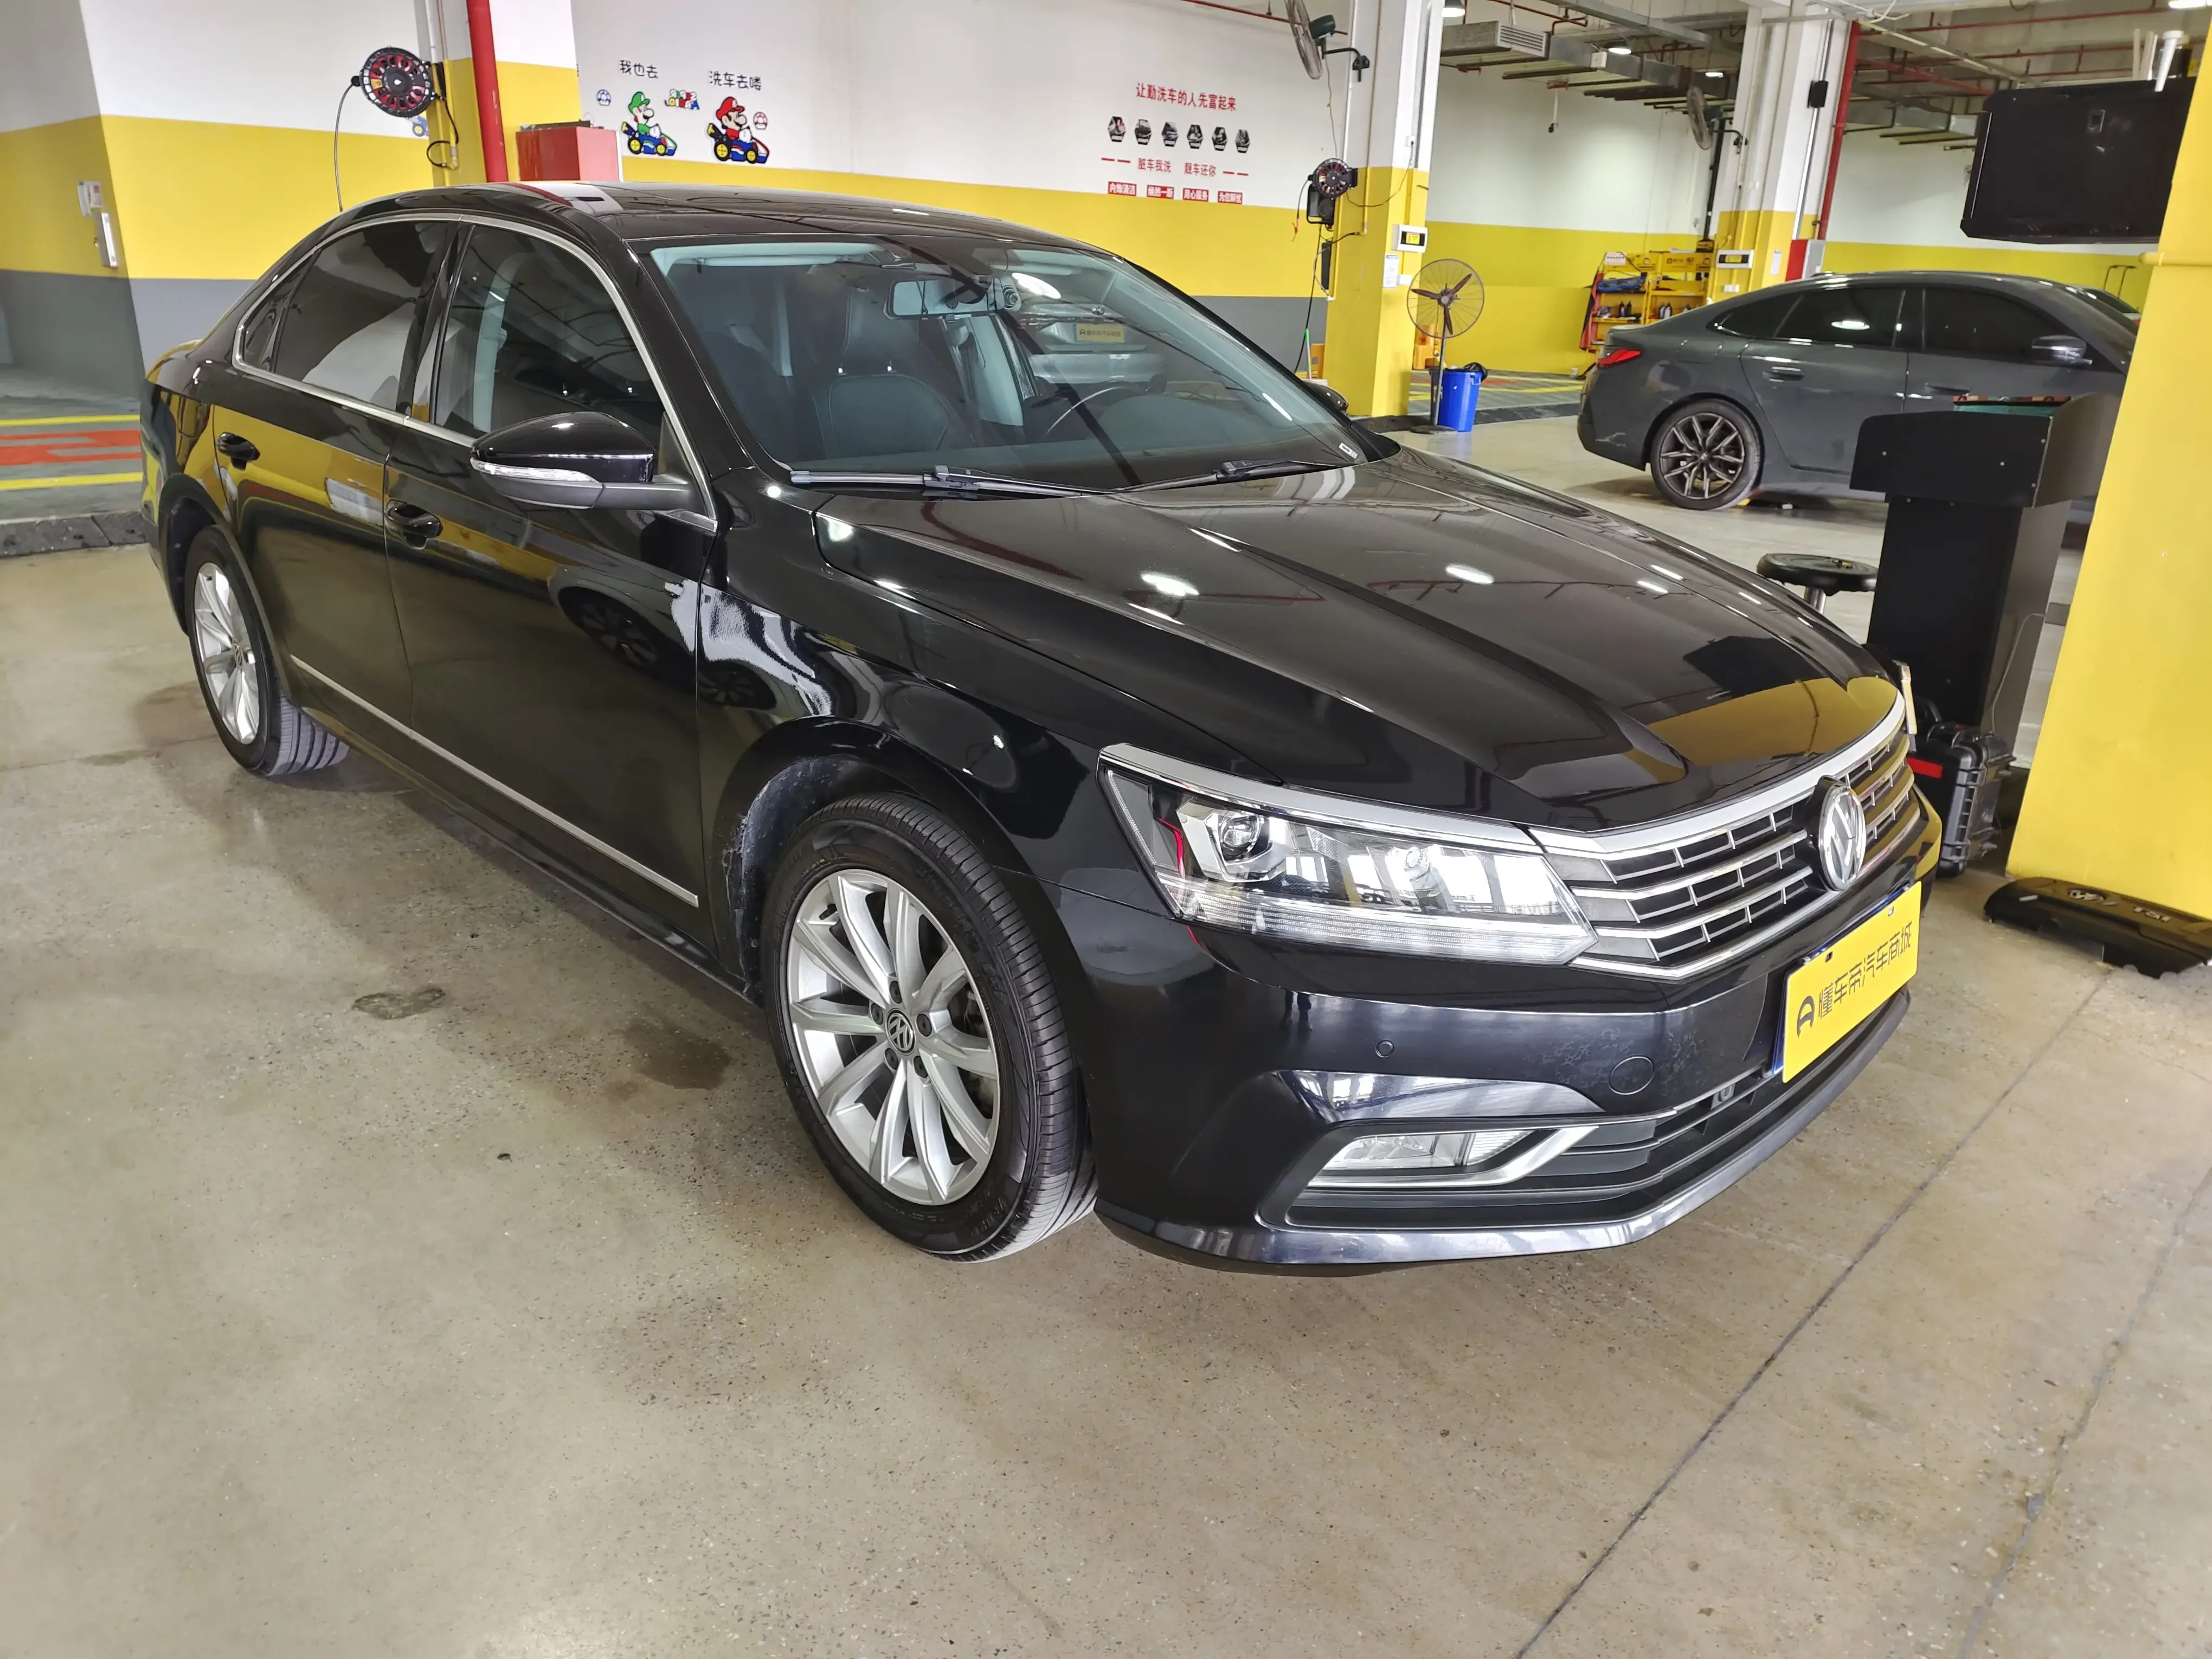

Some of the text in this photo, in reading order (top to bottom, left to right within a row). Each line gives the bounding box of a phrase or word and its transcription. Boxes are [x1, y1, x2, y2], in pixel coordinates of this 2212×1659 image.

[620, 60, 659, 79] 我也去
[1135, 82, 1237, 112] 让勤洗车的人先富起来
[1137, 157, 1172, 173] 脏车我洗
[1818, 921, 1912, 1019] 懂车帝汽车商城
